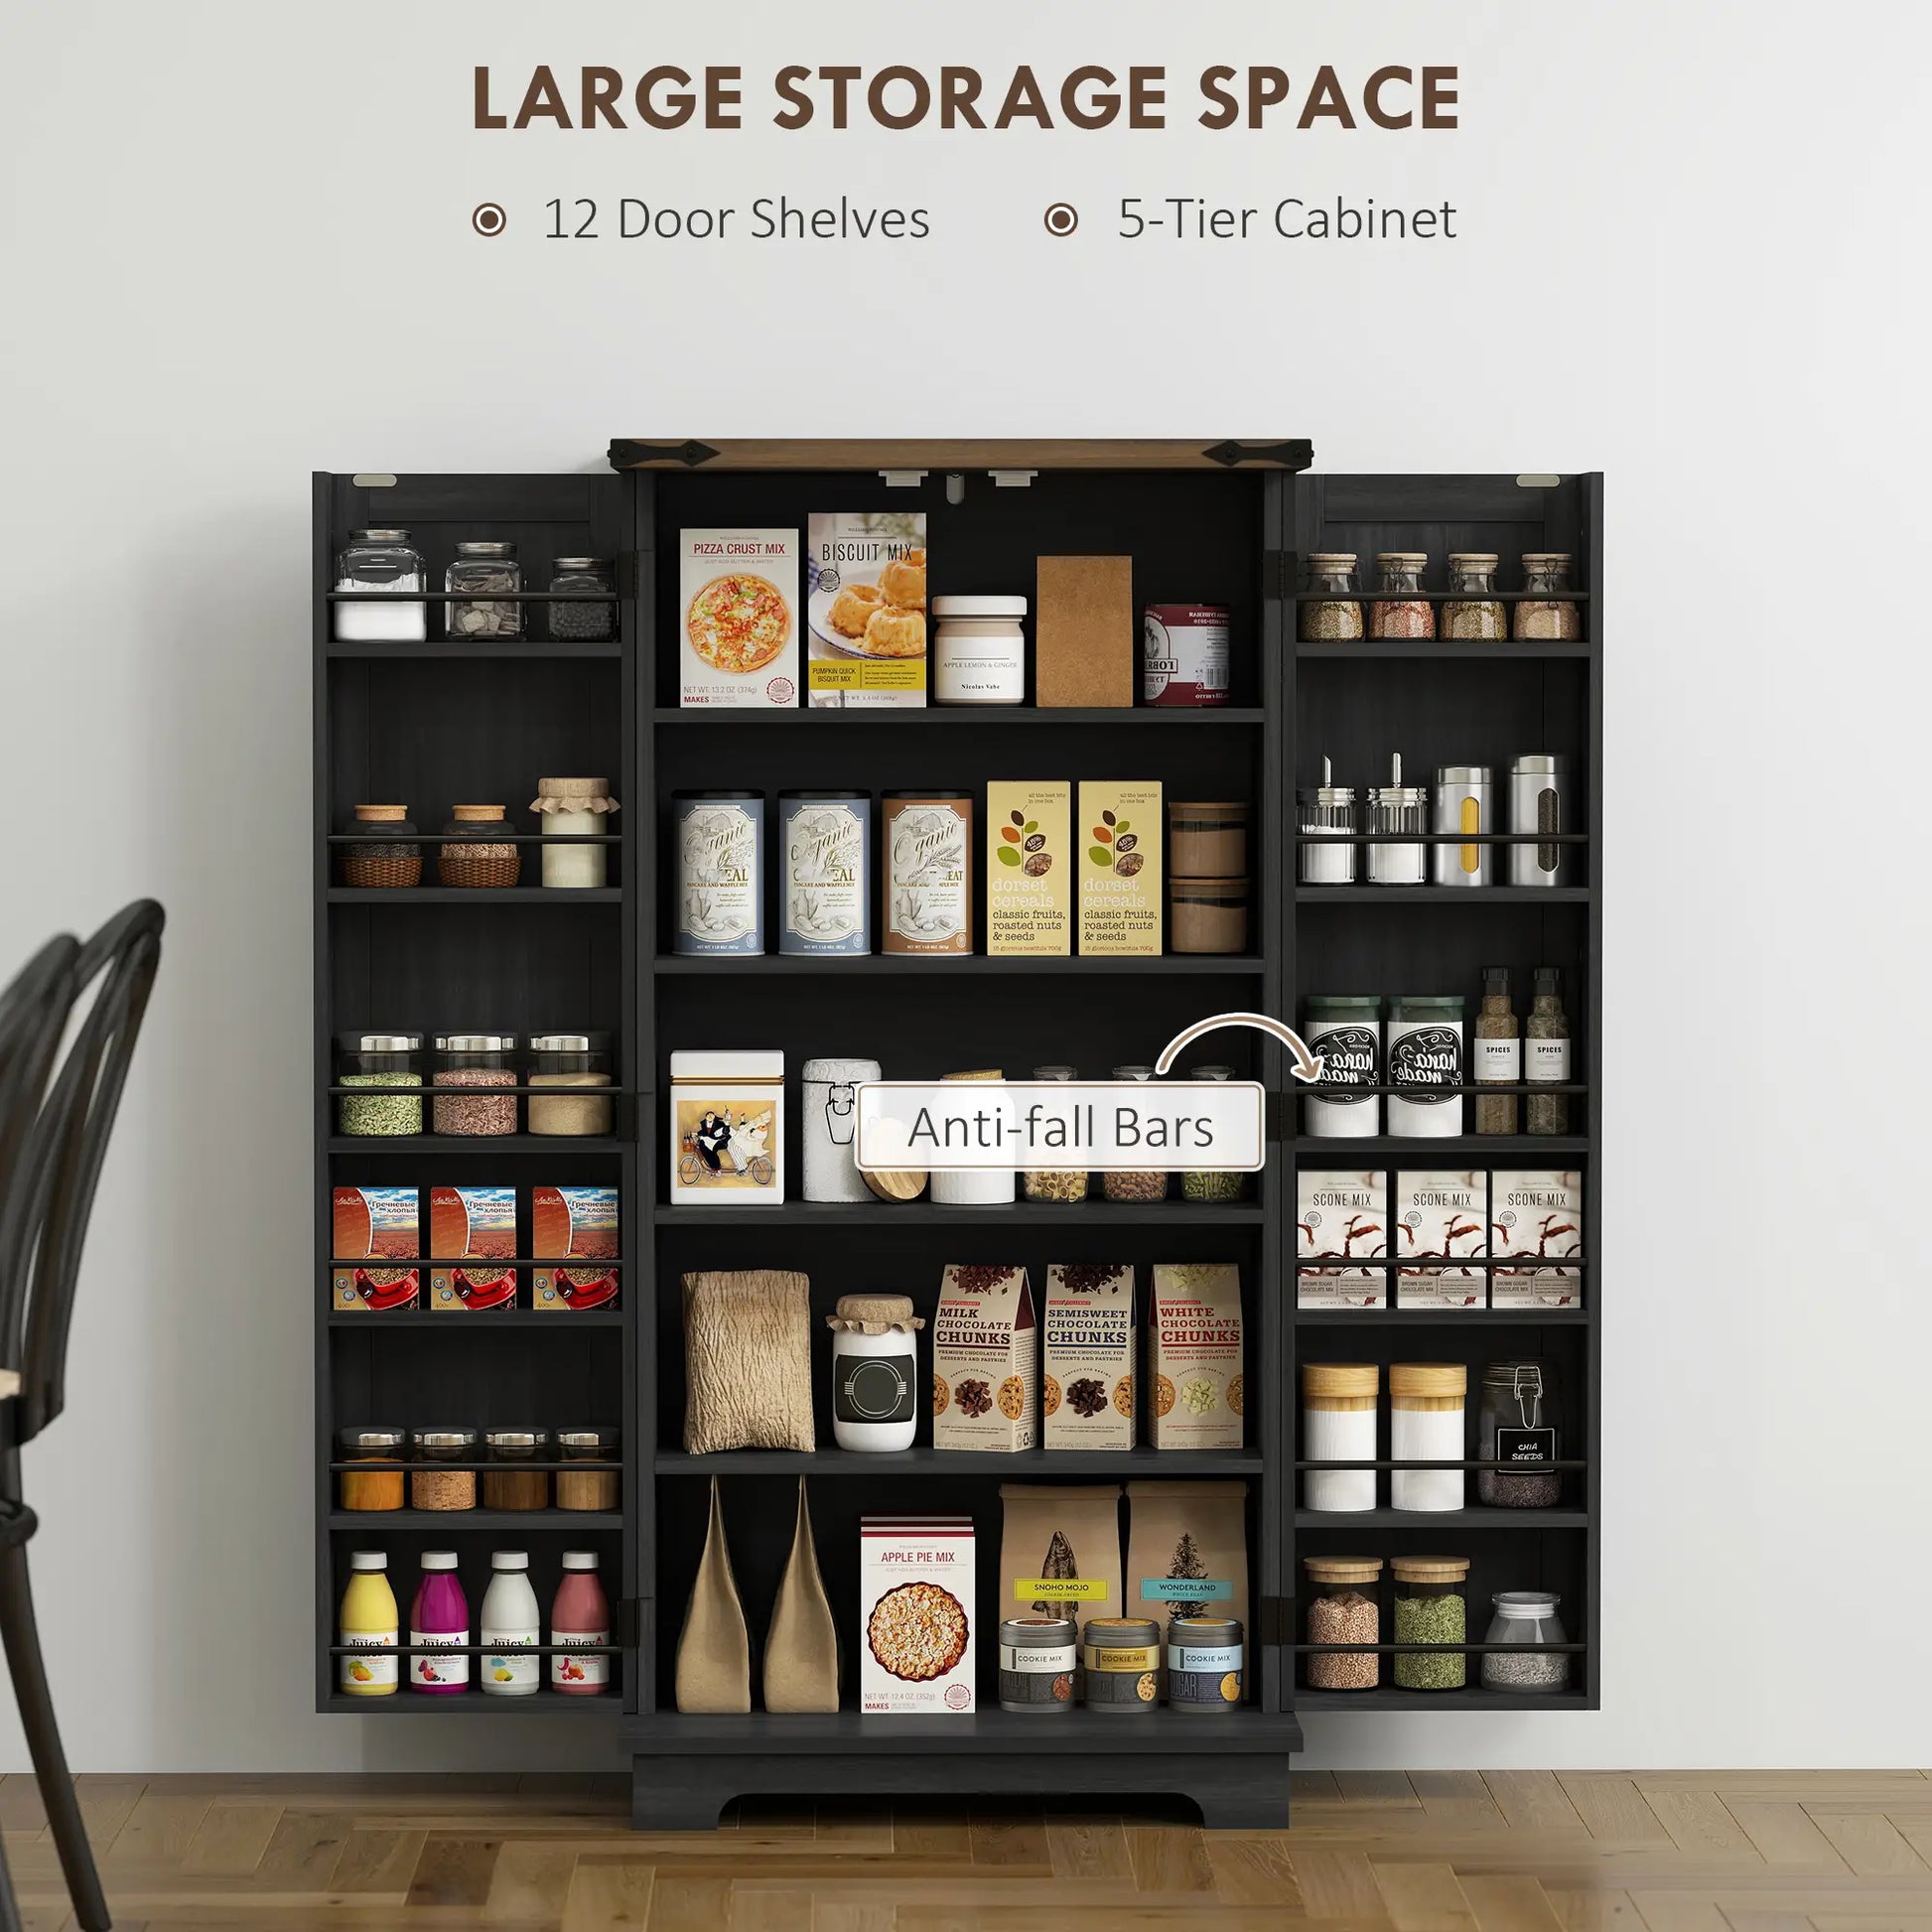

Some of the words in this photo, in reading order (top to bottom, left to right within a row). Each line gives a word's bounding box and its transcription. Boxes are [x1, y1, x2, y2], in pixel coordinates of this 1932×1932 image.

[694, 543, 724, 555] PIZZA
[727, 543, 762, 555] CRUST
[765, 543, 785, 555] MIX
[822, 543, 880, 561] BISCUIT
[888, 543, 912, 561] MIX
[993, 878, 1047, 892] dorset
[1084, 878, 1140, 892] dorset
[993, 895, 1054, 907] cereals
[1084, 895, 1146, 907] cereals
[993, 909, 1030, 919] classic
[1033, 909, 1066, 919] fruits,
[1084, 909, 1121, 919] classic
[1124, 909, 1158, 919] fruits,
[993, 920, 1034, 930] roasted
[1036, 921, 1062, 930] nuts
[1084, 920, 1125, 930] roasted
[1128, 921, 1154, 930] nuts
[993, 931, 1002, 941] &
[1005, 931, 1035, 941] seeds
[1084, 931, 1093, 941] &
[1096, 931, 1127, 941] seeds
[1312, 1193, 1347, 1206] SCONE
[1352, 1193, 1371, 1206] MIX
[1413, 1193, 1448, 1206] SCONE
[1452, 1193, 1471, 1206] MIX
[1508, 1193, 1542, 1206] SCONE
[1548, 1193, 1566, 1206] MIX
[939, 1309, 979, 1317] MILK
[1048, 1310, 1127, 1318] SEMISWEET
[1160, 1308, 1214, 1317] WHITE
[937, 1320, 1012, 1330] CHOCOLATE
[936, 1331, 1011, 1344] CHUNKS
[1047, 1331, 1127, 1343] CHUNKS
[1162, 1330, 1240, 1342] CHUNKS
[881, 1552, 913, 1563] APPLE
[916, 1552, 932, 1563] PIE
[935, 1552, 955, 1563] MIX
